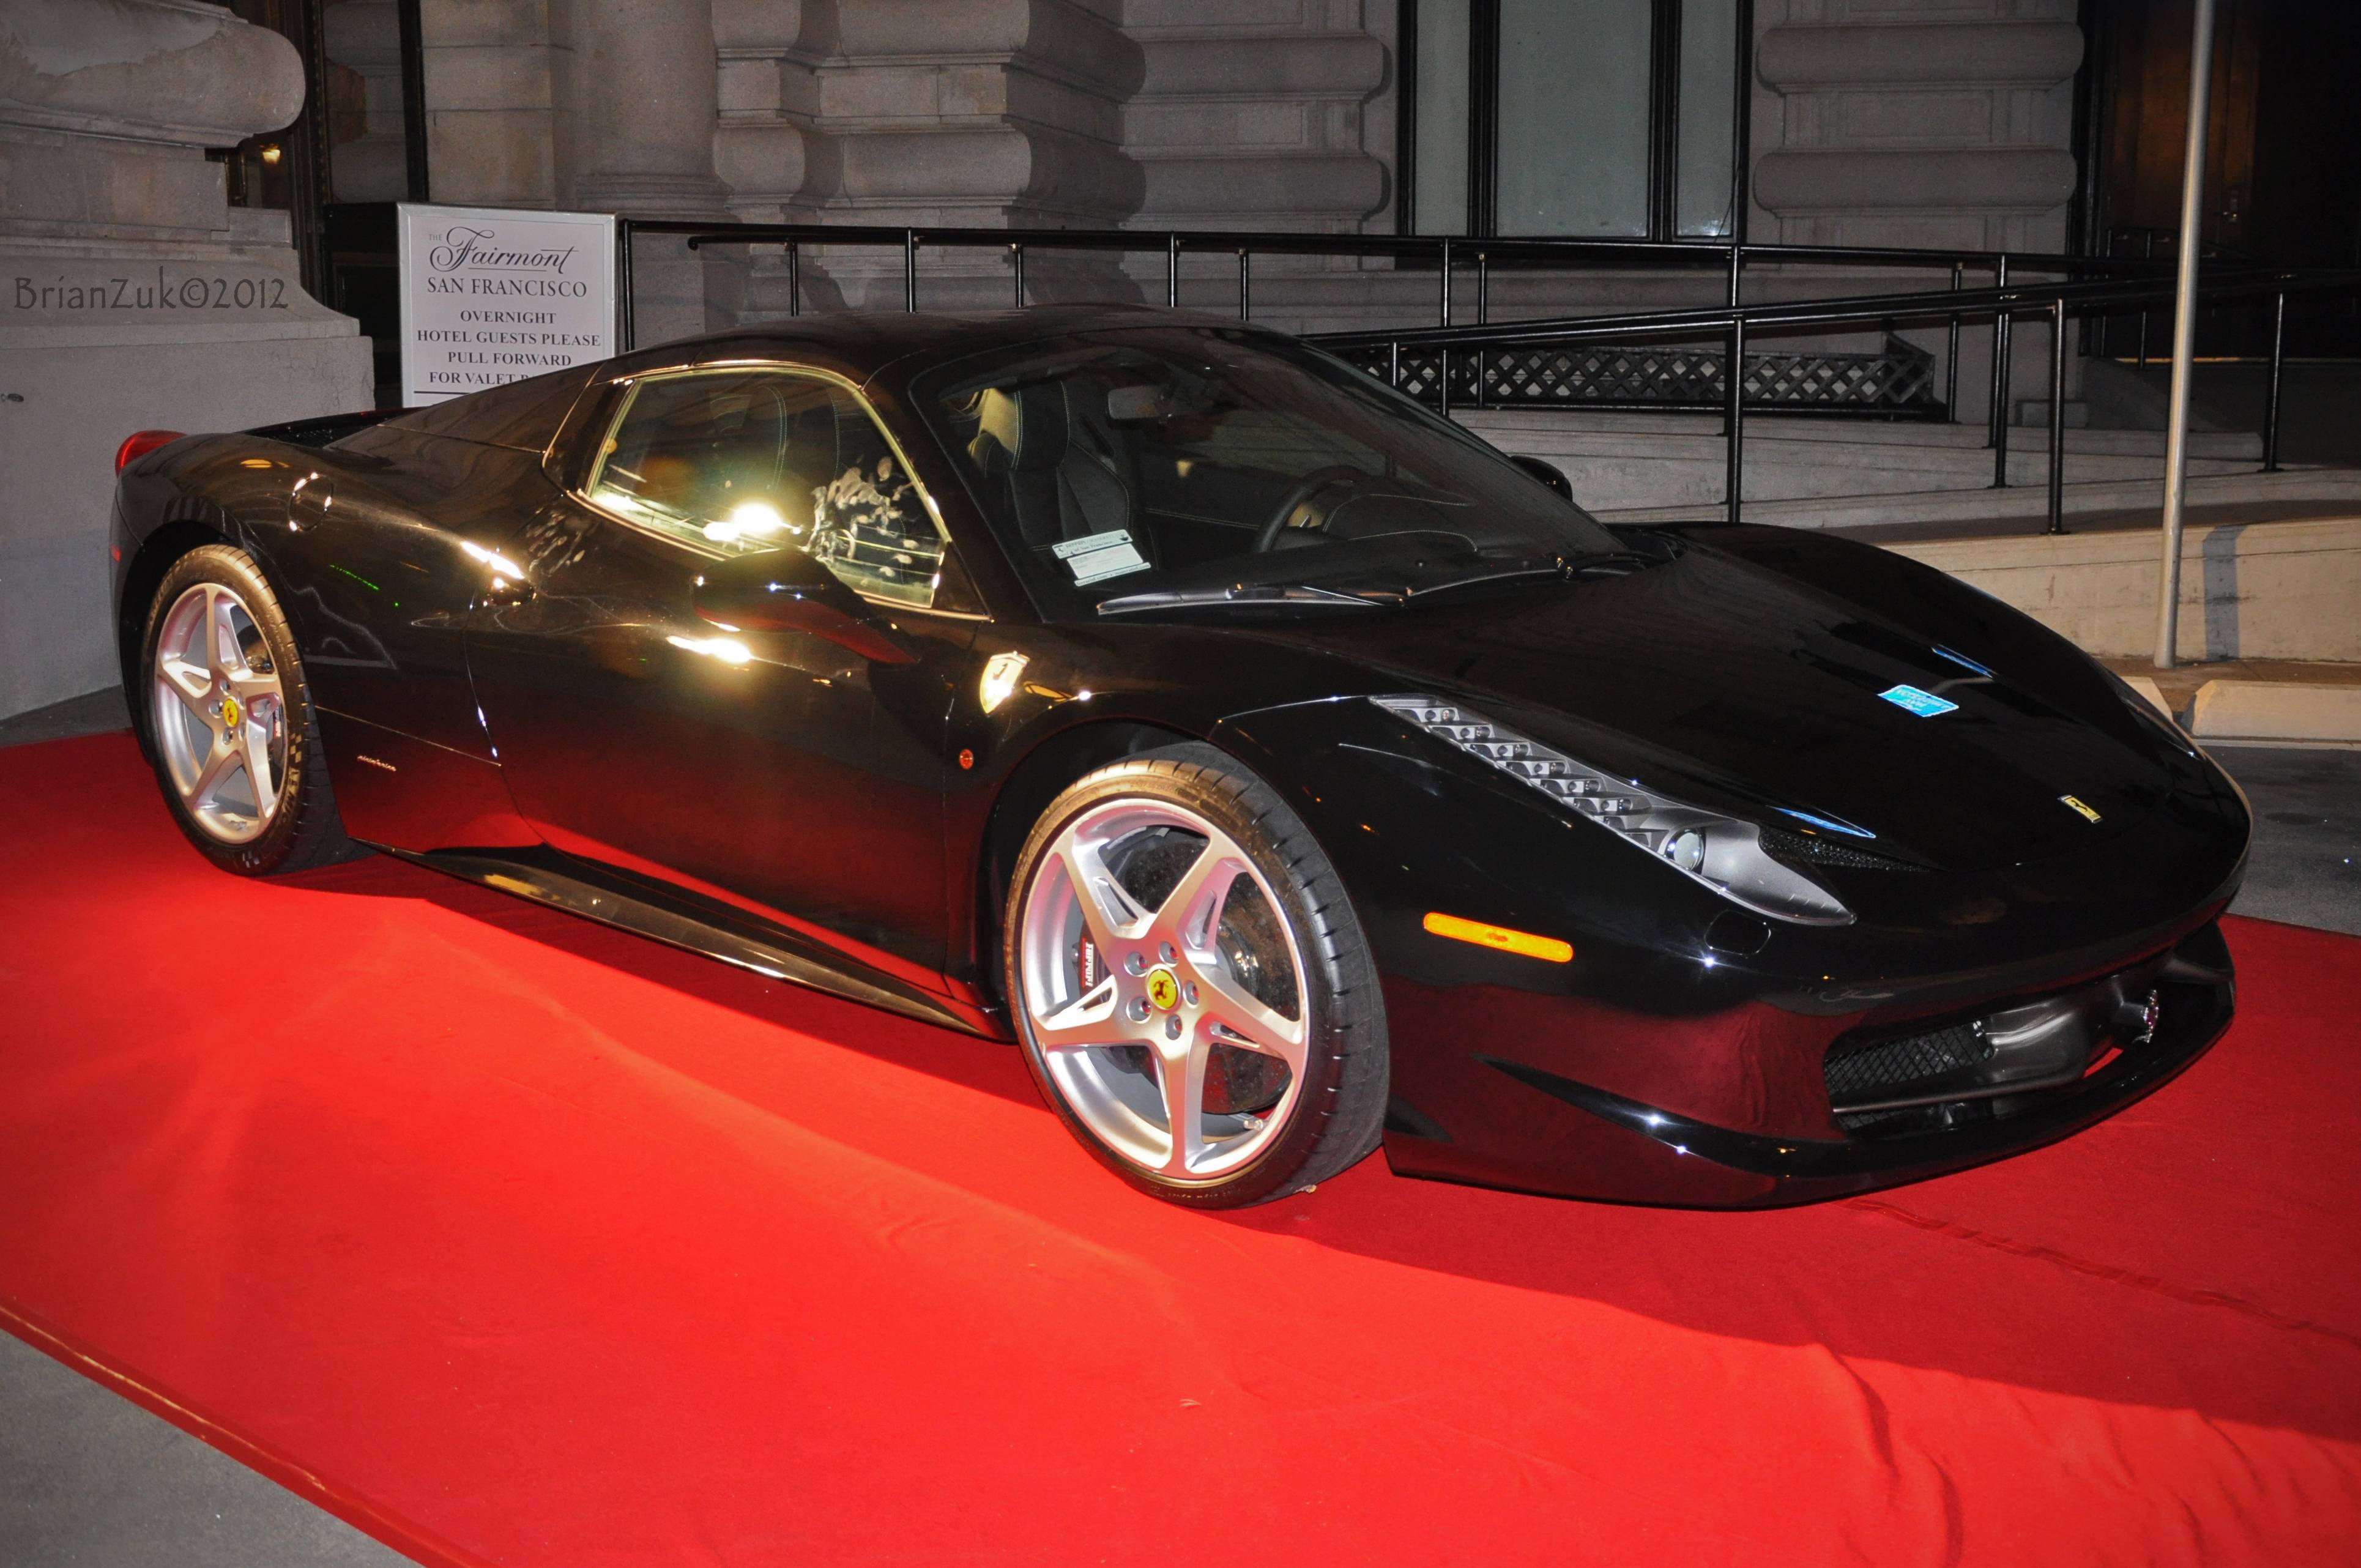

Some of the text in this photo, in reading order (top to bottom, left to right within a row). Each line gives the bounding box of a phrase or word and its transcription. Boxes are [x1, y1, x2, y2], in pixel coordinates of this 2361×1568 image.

[429, 226, 579, 275] Fairmont
[428, 277, 587, 297] SAN FRANCISCO
[461, 310, 557, 324] OVERNIGHT
[417, 330, 601, 347] HOTEL GUESTS PLEASE
[448, 352, 571, 366] PULL FORWARD
[429, 371, 461, 384] FOR
[465, 372, 516, 385] VALET
